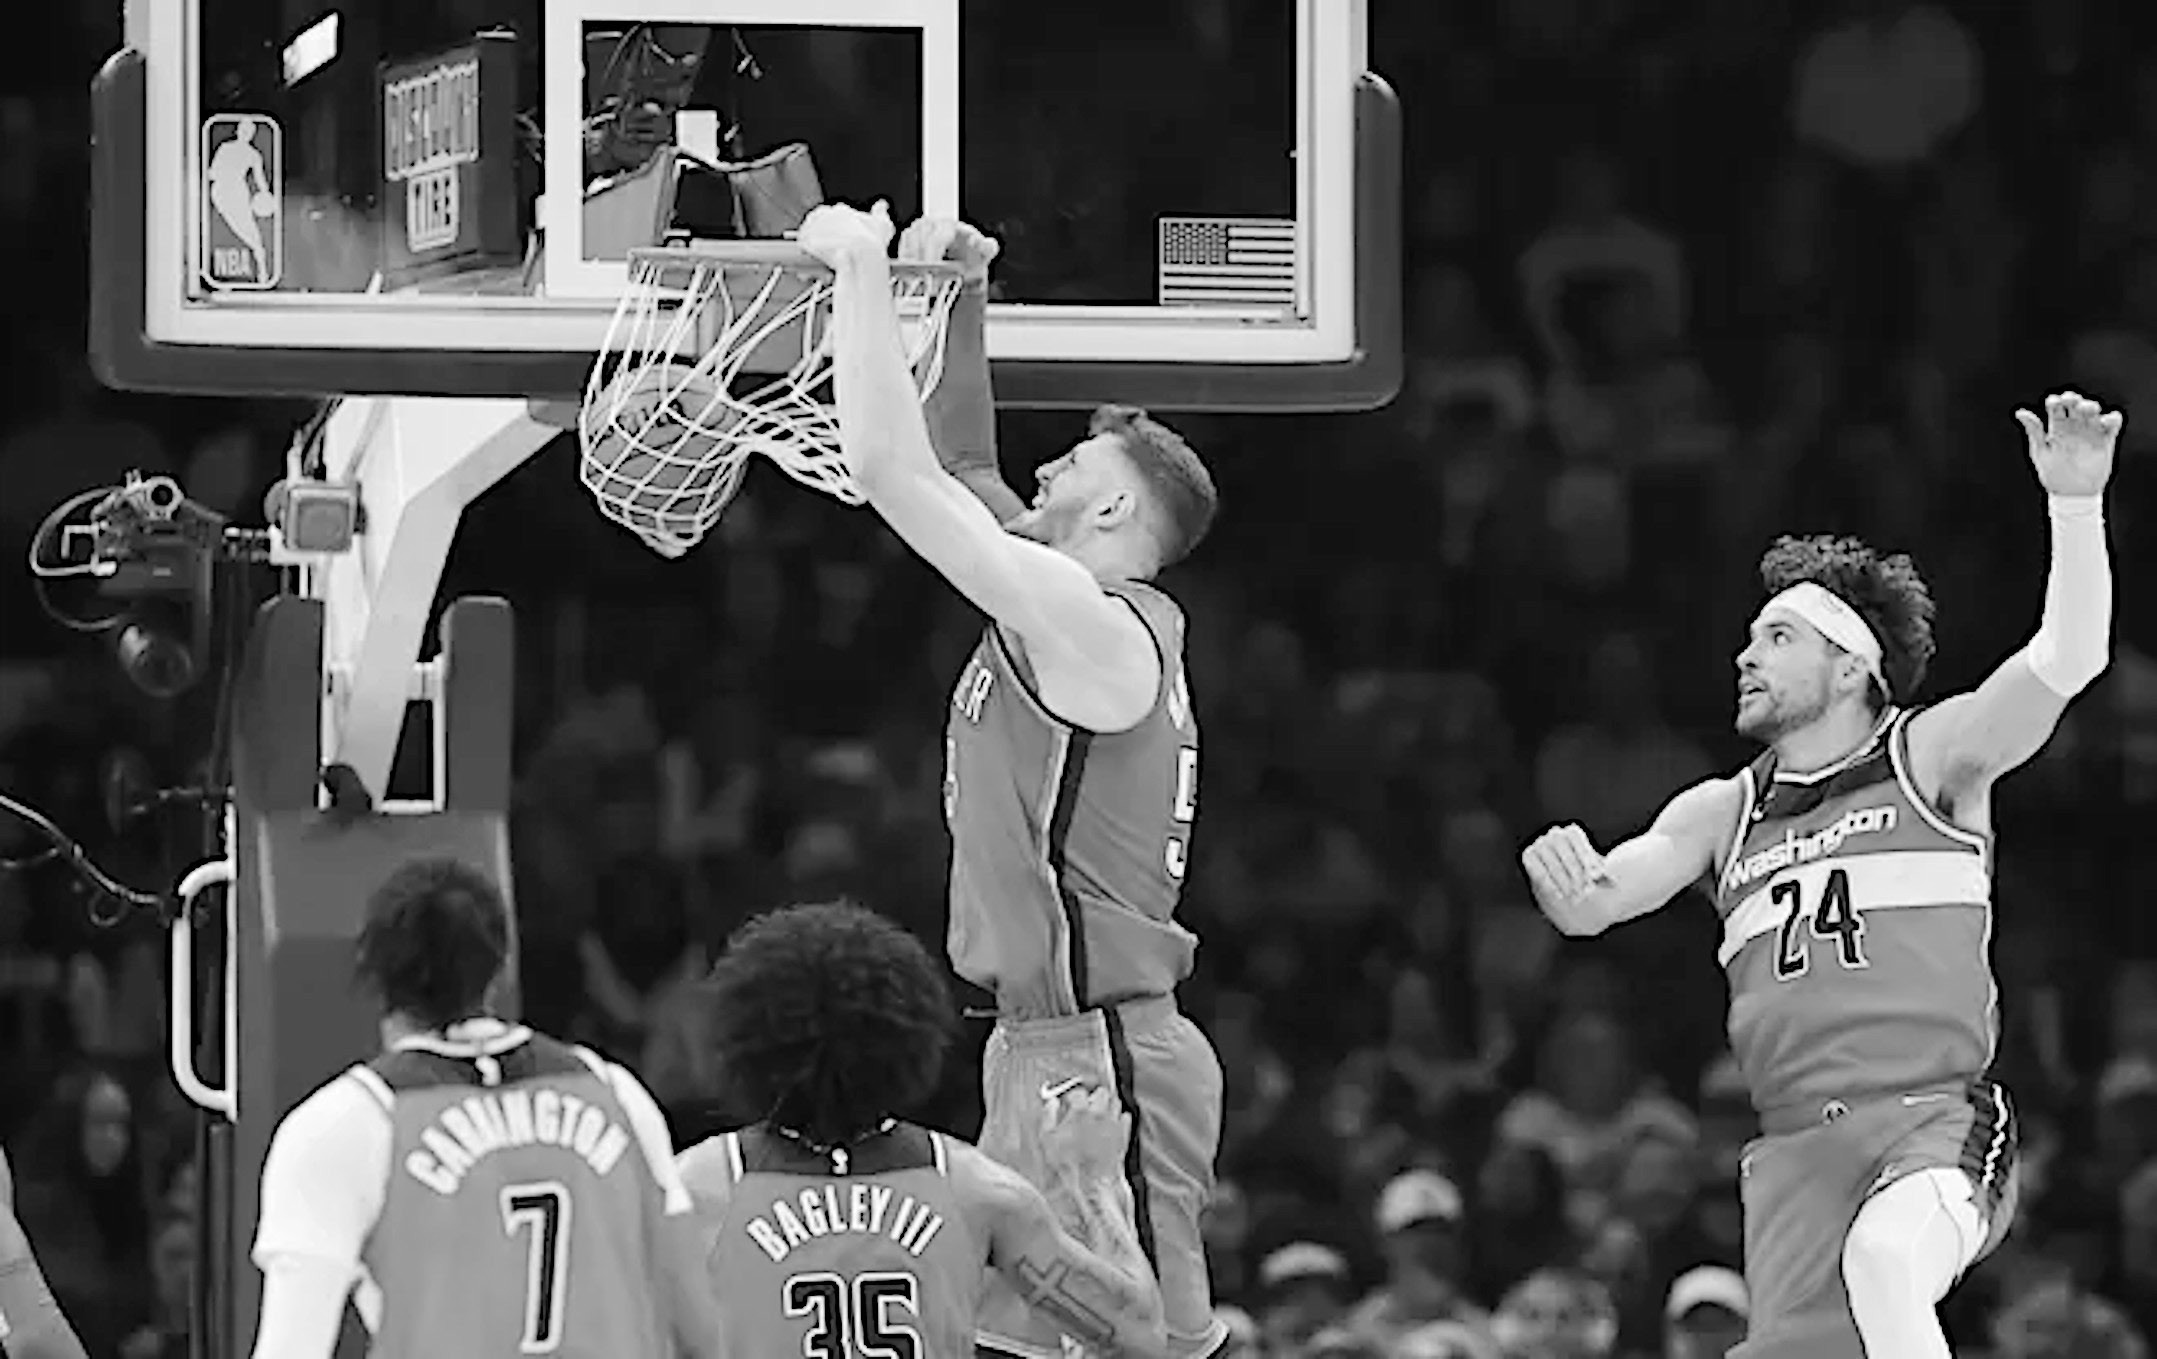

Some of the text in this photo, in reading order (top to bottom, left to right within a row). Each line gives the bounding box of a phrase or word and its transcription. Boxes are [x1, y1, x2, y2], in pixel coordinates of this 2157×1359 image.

[214, 247, 254, 277] NBA
[1771, 868, 1871, 981] 24
[405, 1088, 630, 1195] CARRINGTON
[500, 1180, 572, 1353] 7
[746, 1183, 944, 1263] BAGLEY III
[783, 1271, 923, 1359] 35
